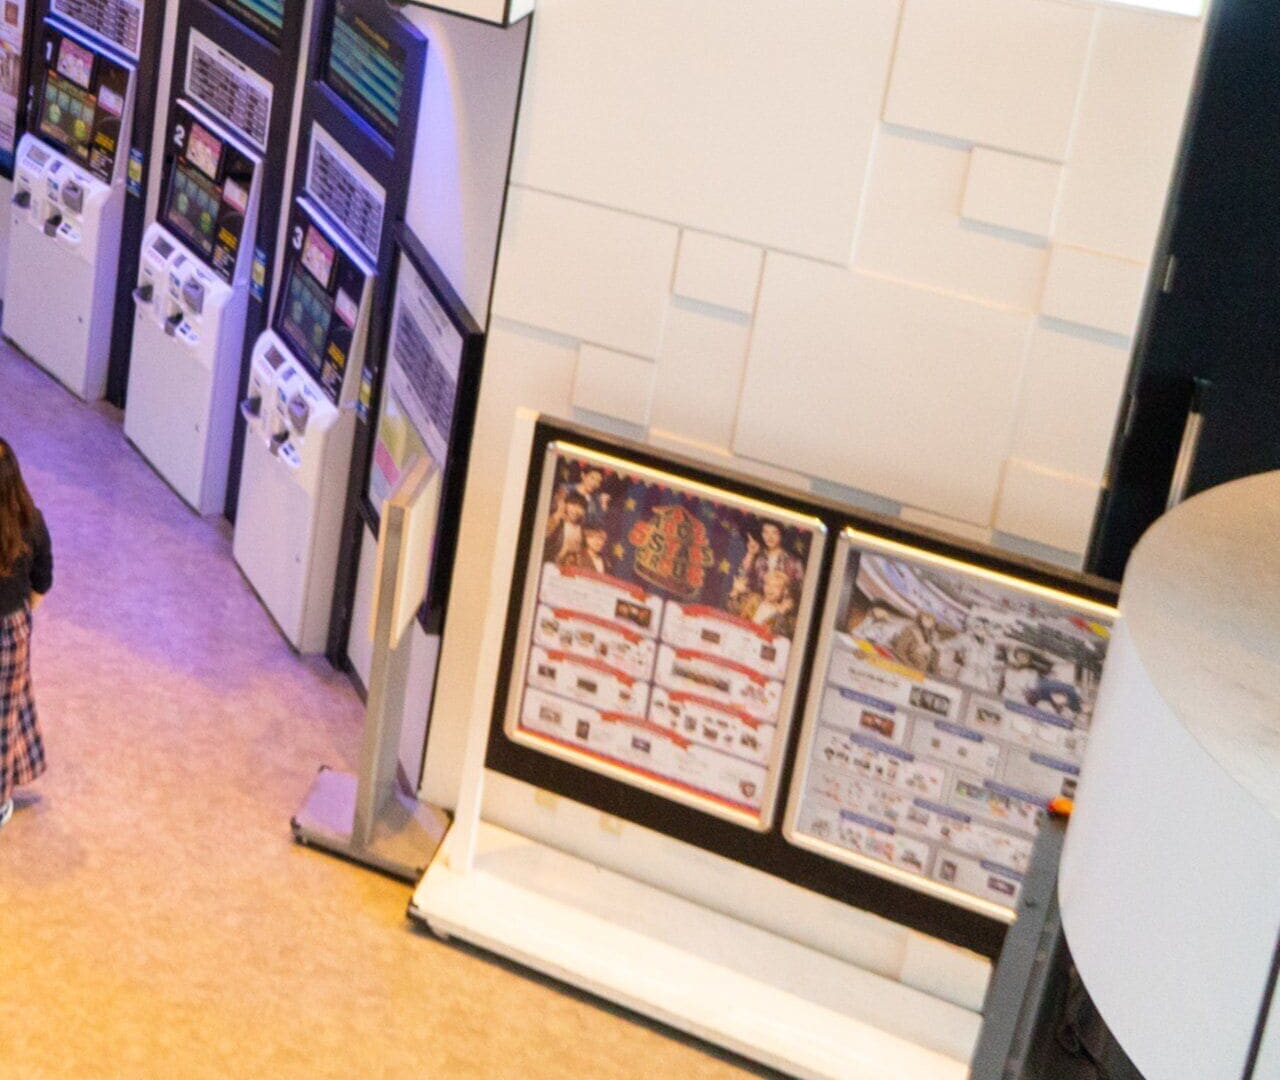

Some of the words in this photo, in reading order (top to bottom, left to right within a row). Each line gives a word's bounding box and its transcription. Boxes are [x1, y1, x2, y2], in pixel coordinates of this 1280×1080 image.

[46, 41, 53, 61] 1
[173, 125, 185, 148] 2
[292, 225, 304, 252] 3
